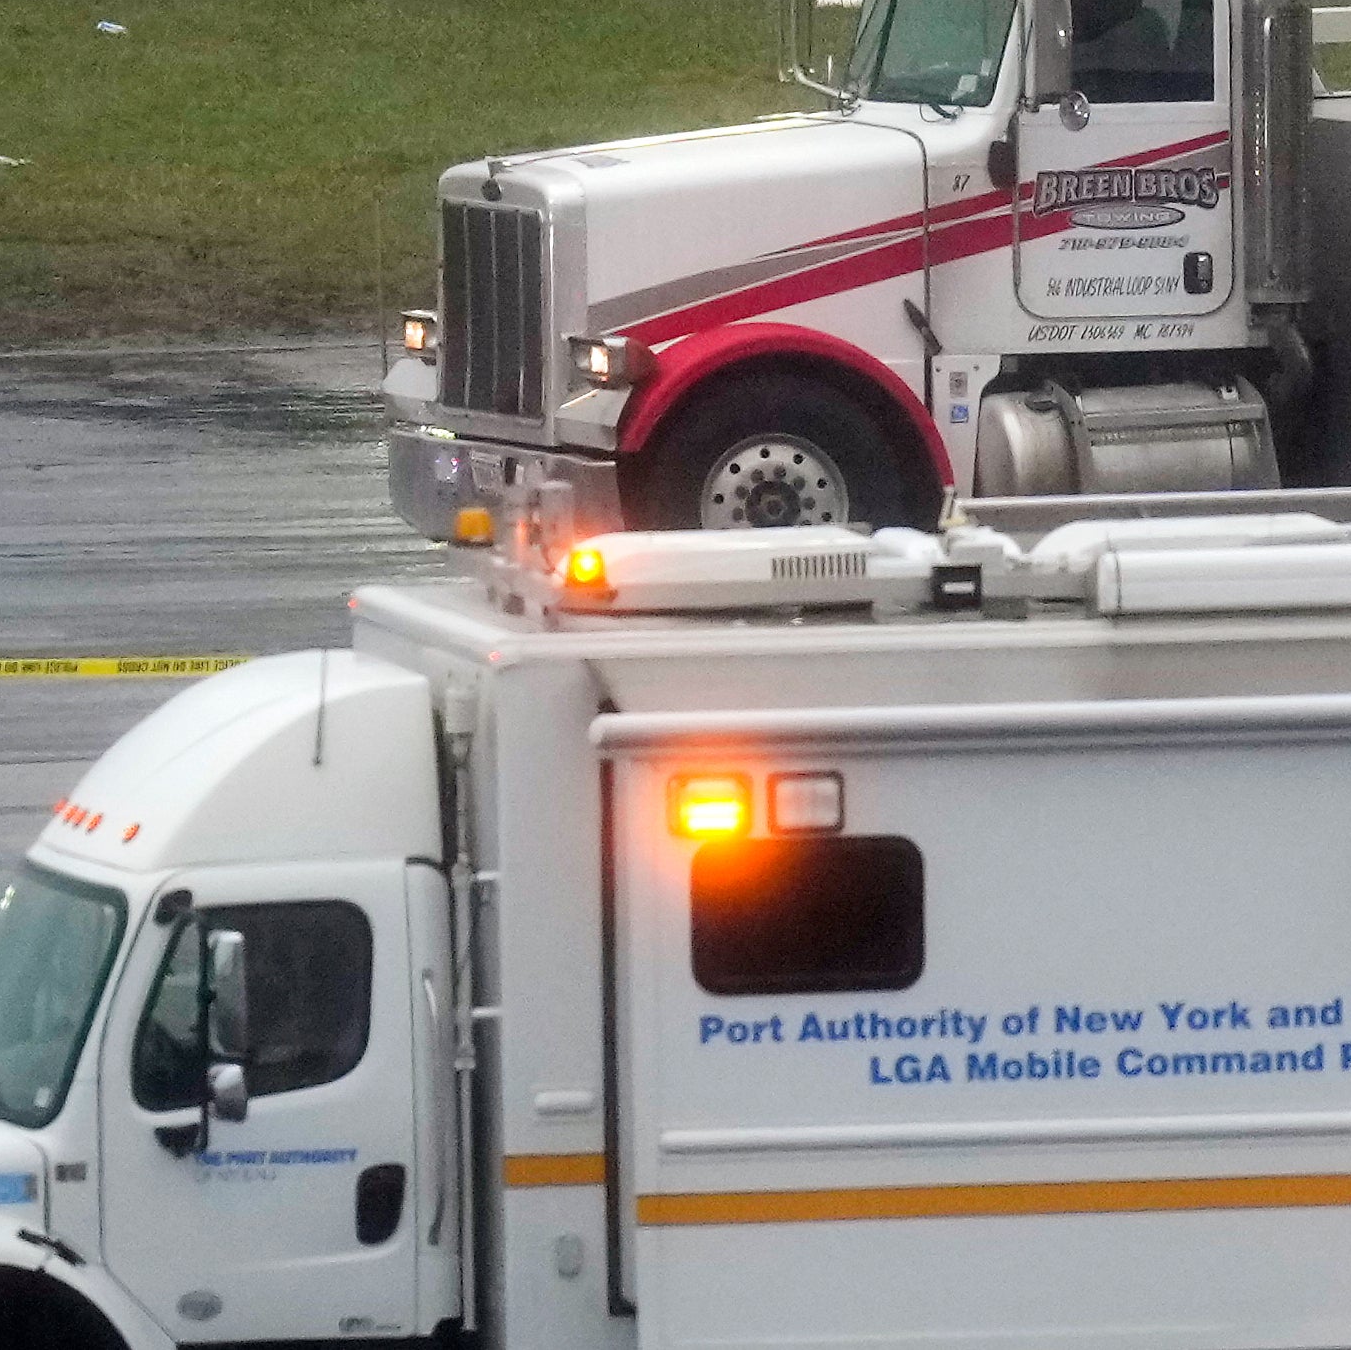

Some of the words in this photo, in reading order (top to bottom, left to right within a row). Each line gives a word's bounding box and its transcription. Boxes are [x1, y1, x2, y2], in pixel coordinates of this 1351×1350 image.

[1035, 171, 1132, 215] BREEN
[1136, 168, 1219, 207] BROS
[1028, 325, 1079, 342] USDOT
[699, 1013, 784, 1045] Port
[798, 1008, 988, 1045] Authority
[1001, 1006, 1040, 1036] of
[1054, 1004, 1144, 1034] New
[1159, 1001, 1252, 1031] York
[1268, 997, 1344, 1030] and
[869, 1053, 951, 1085] LGA
[967, 1049, 1102, 1082] Mobile
[1116, 1043, 1325, 1078] Command
